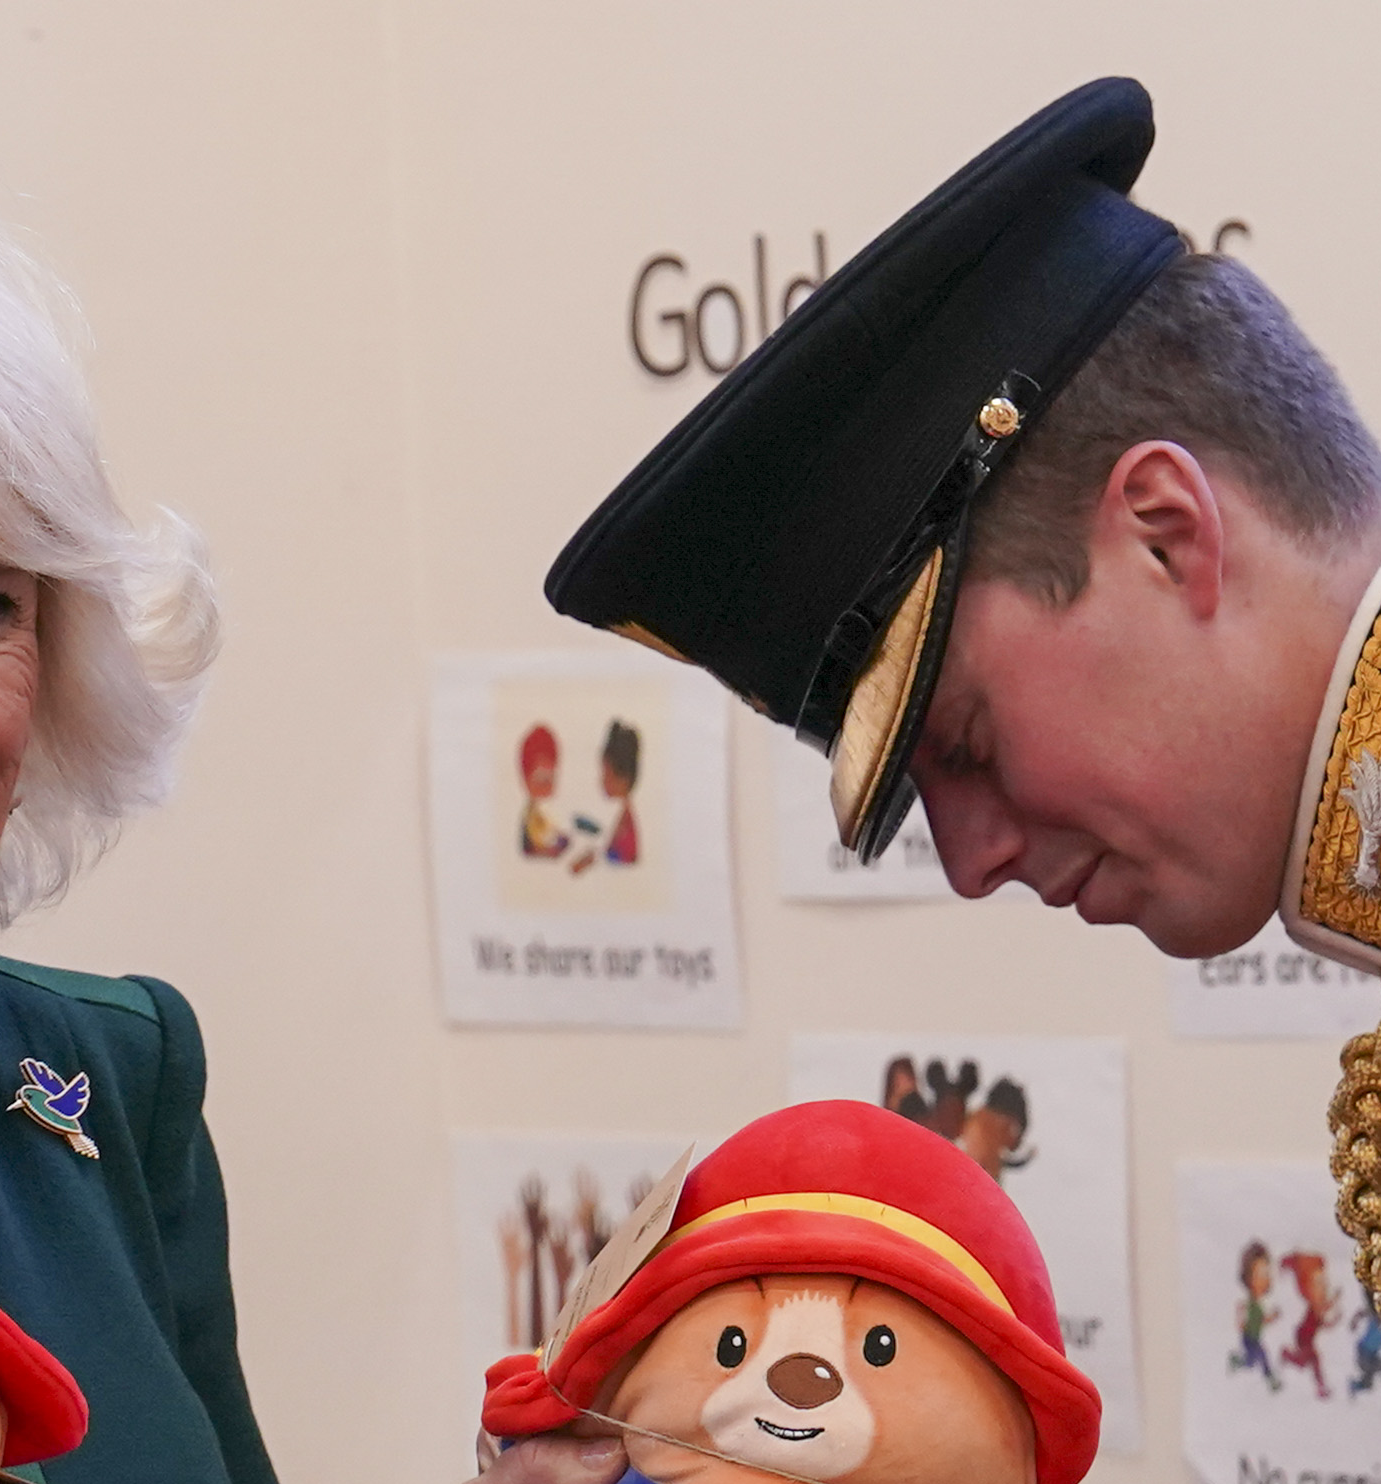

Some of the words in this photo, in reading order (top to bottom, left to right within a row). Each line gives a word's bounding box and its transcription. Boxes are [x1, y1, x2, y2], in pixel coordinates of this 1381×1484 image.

[472, 935, 517, 976] We
[522, 934, 597, 978] share
[602, 946, 645, 980] our
[653, 941, 717, 992] toys
